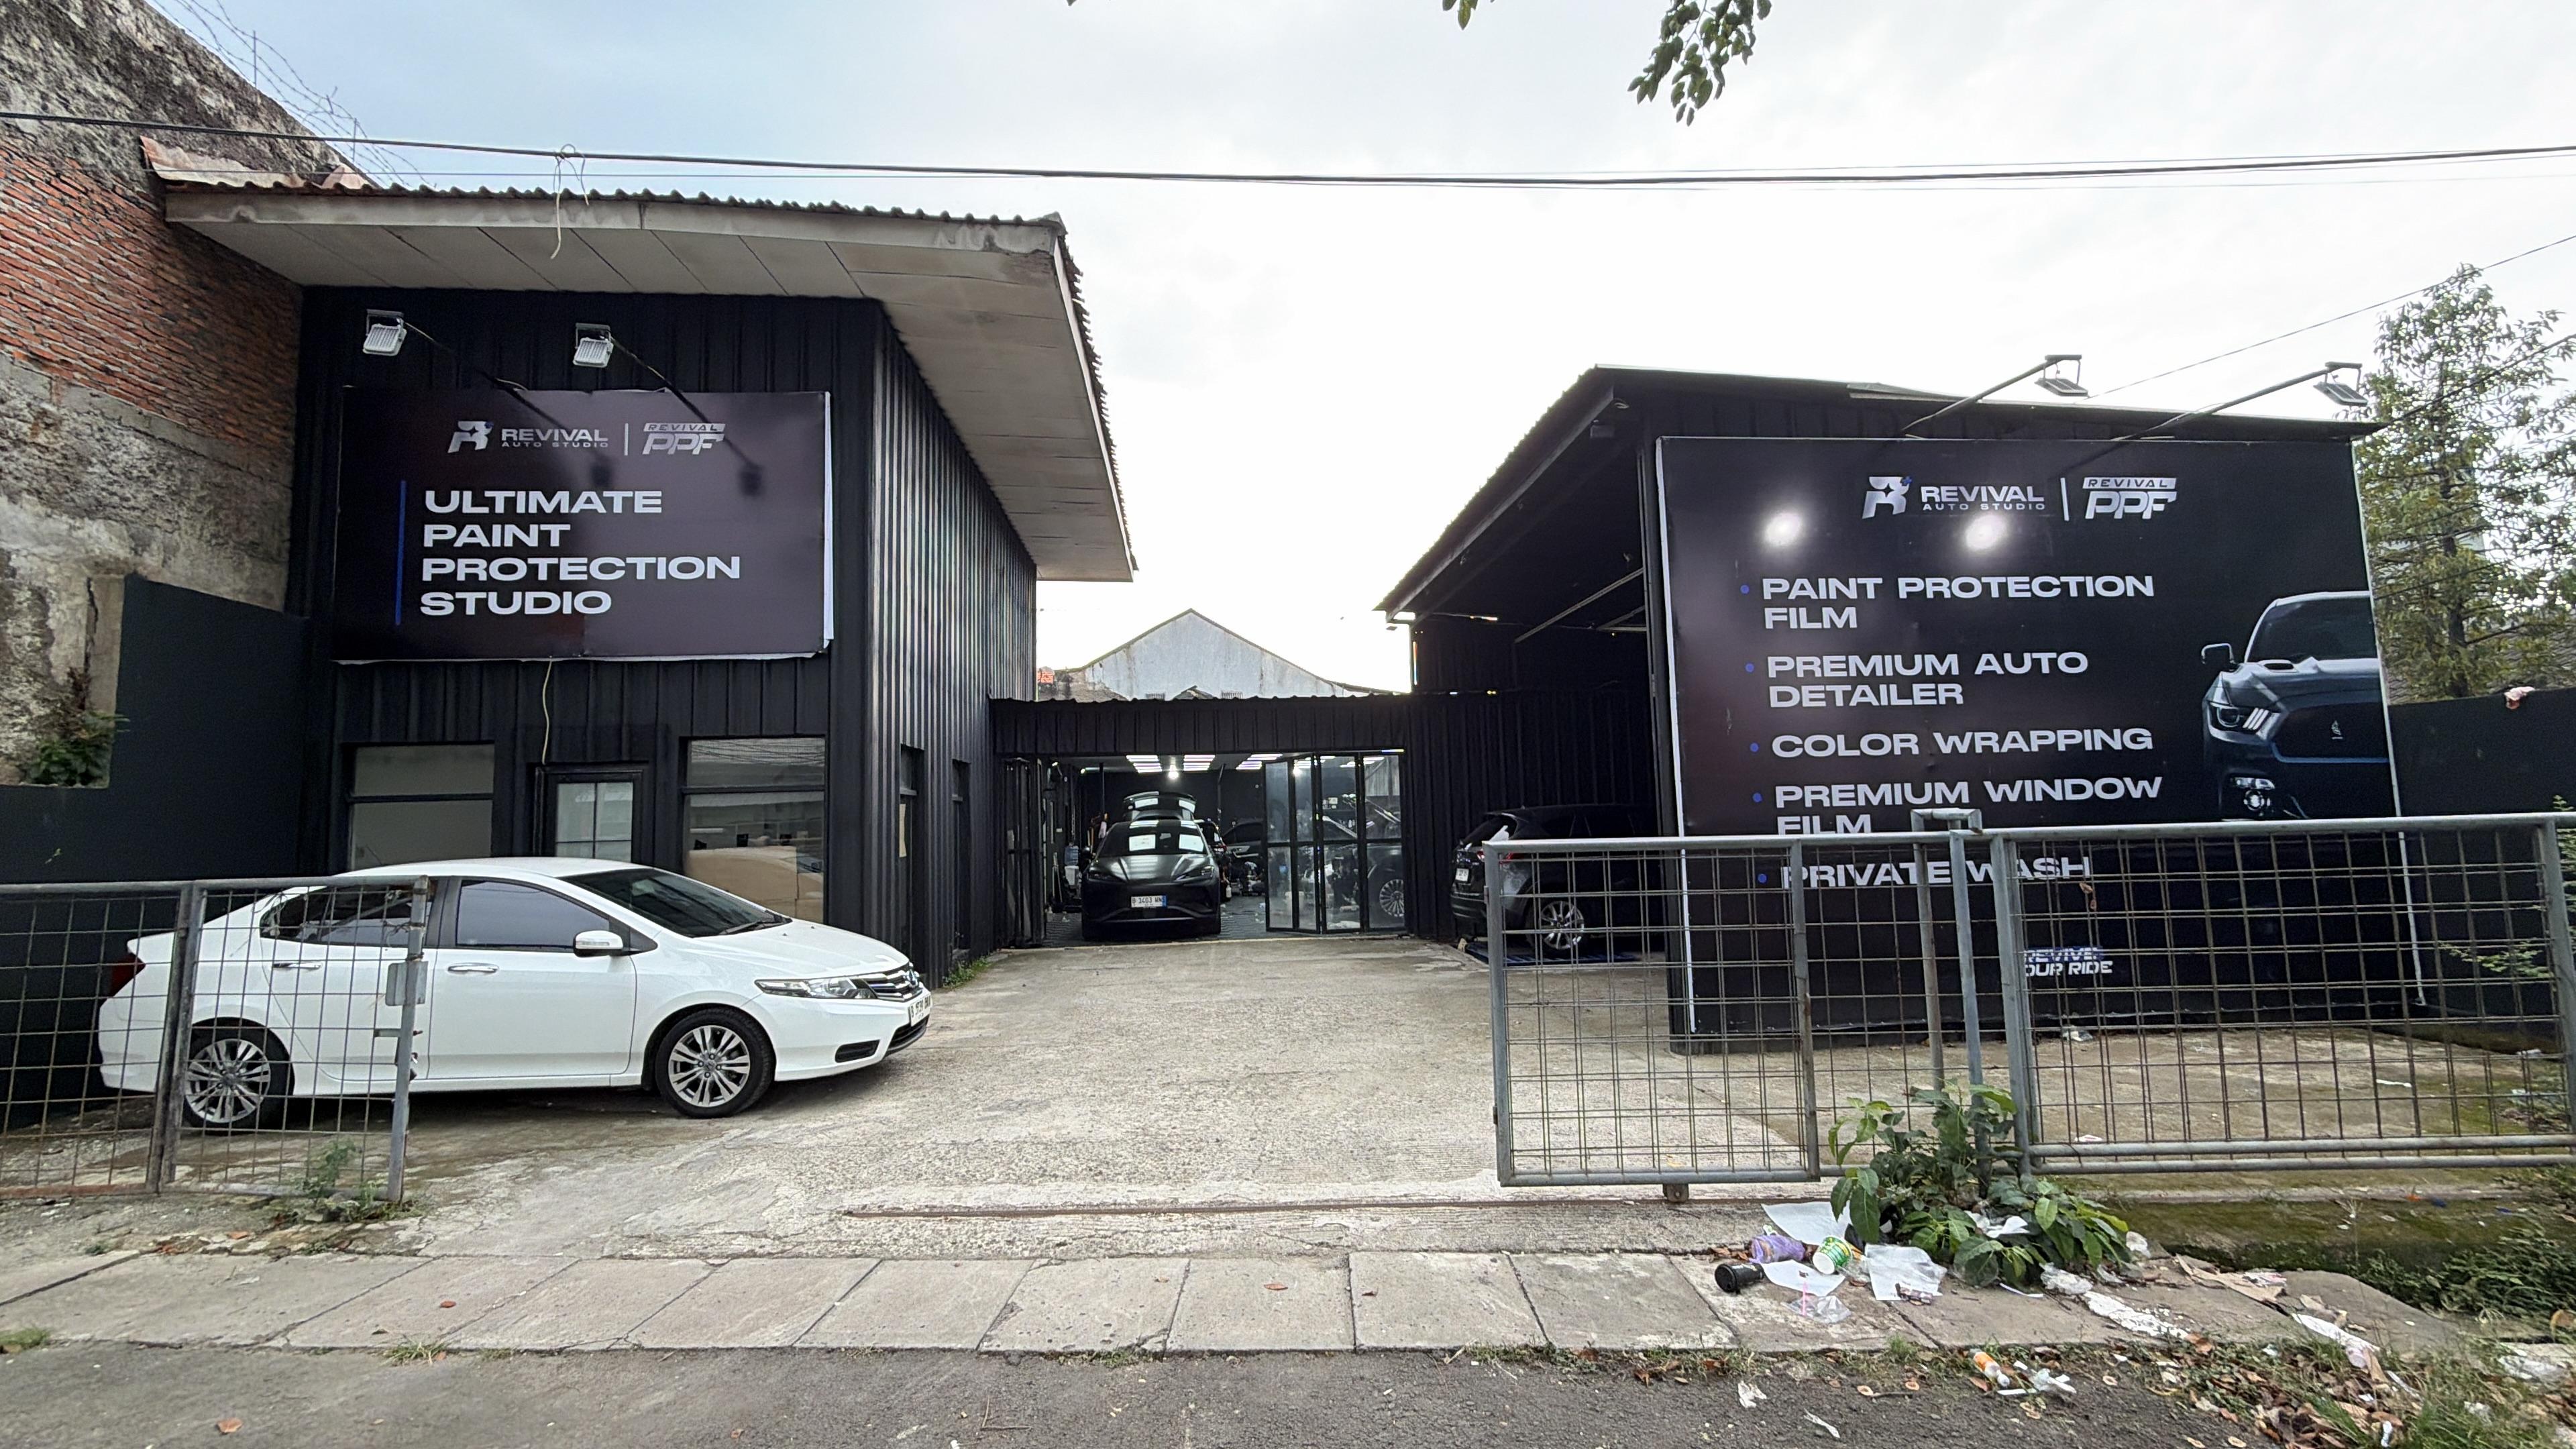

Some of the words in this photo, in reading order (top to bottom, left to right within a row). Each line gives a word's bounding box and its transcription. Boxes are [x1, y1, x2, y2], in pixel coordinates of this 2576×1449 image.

[502, 429, 608, 441] REVIVAL
[642, 433, 725, 455] PPF
[1921, 486, 2045, 502] REVIVAL
[2088, 478, 2168, 488] REVIVAL
[425, 490, 662, 514] ULTIMATE
[2084, 491, 2178, 519] PPF
[423, 524, 571, 547] PAINT
[422, 556, 741, 582] PROTECTION
[1762, 578, 1883, 600] PAINT
[1897, 576, 2155, 599] PROTECTION
[420, 590, 612, 616] STUDIO
[1764, 606, 1858, 629] FILM
[1767, 653, 1960, 678] PREMIUM
[1974, 651, 2088, 675] AUTO
[1769, 683, 1964, 708] DETAILER
[1772, 733, 1920, 757] COLOR
[1933, 728, 2153, 754] WRAPPING
[1775, 782, 1970, 808] PREMIUM
[1983, 776, 2163, 803] WINDOW
[1777, 814, 1872, 835] FILM
[1780, 861, 1951, 890] PRIVATE
[2024, 961, 2063, 977] OUR
[2068, 960, 2113, 976] RIDE
